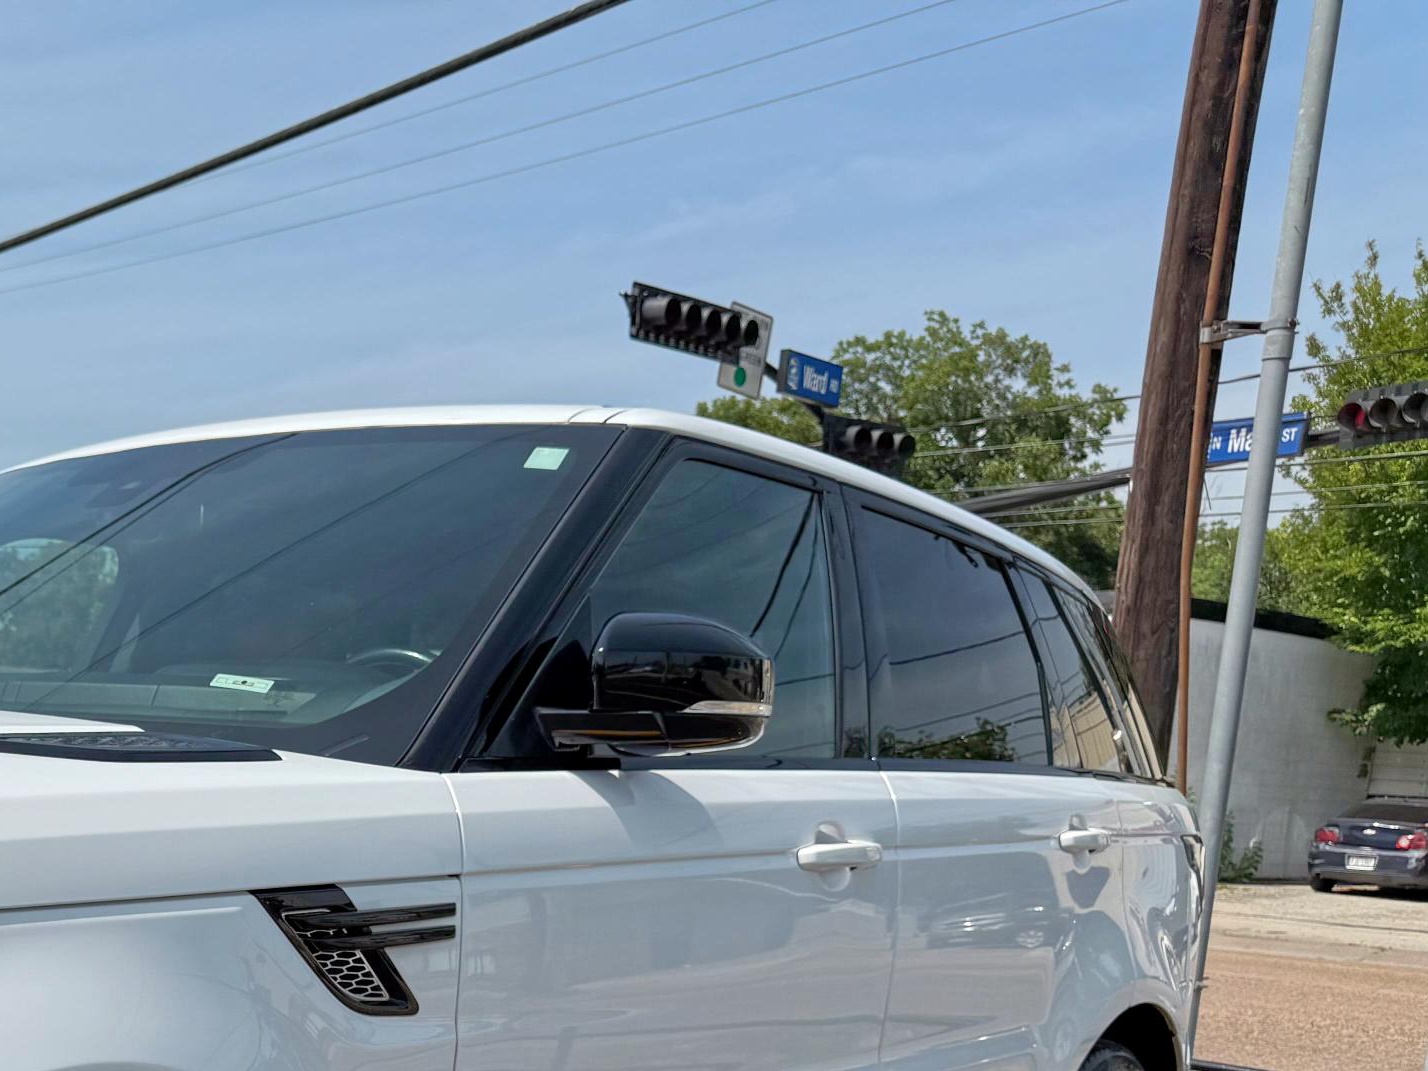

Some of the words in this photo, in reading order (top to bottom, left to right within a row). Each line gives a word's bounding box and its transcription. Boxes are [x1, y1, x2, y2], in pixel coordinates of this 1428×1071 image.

[803, 365, 828, 395] Ward
[1212, 436, 1222, 450] N
[1227, 427, 1254, 454] Ma
[1281, 427, 1298, 443] ST
